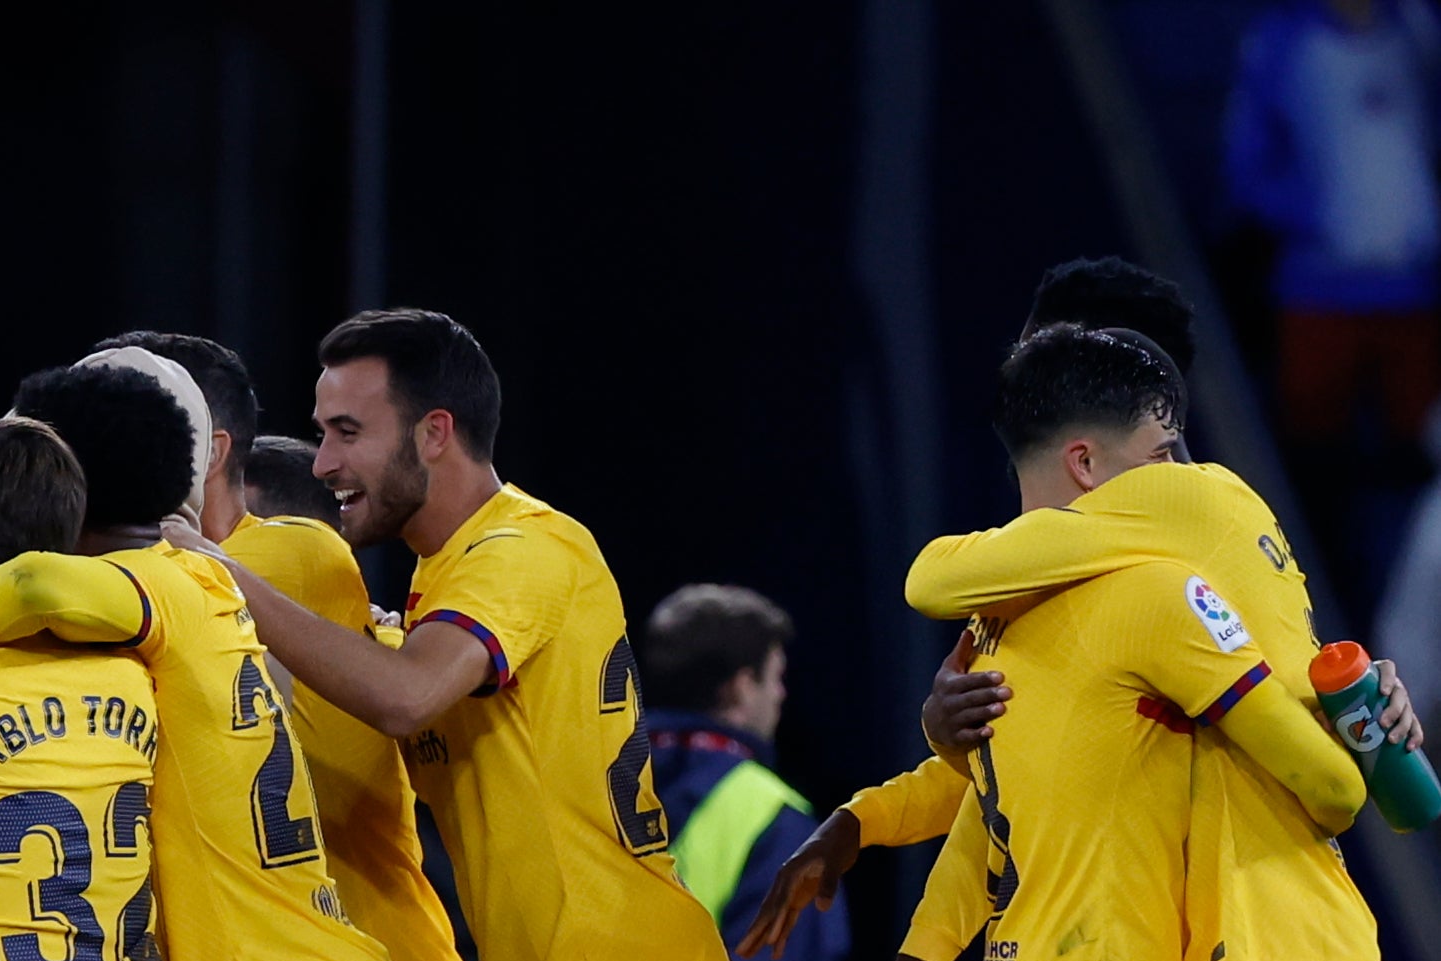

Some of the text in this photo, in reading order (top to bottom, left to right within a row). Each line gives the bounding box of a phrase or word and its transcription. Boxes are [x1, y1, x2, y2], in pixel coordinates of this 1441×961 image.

[232, 654, 325, 870] 2
[599, 633, 670, 857] 2
[990, 940, 1019, 959] HCR
